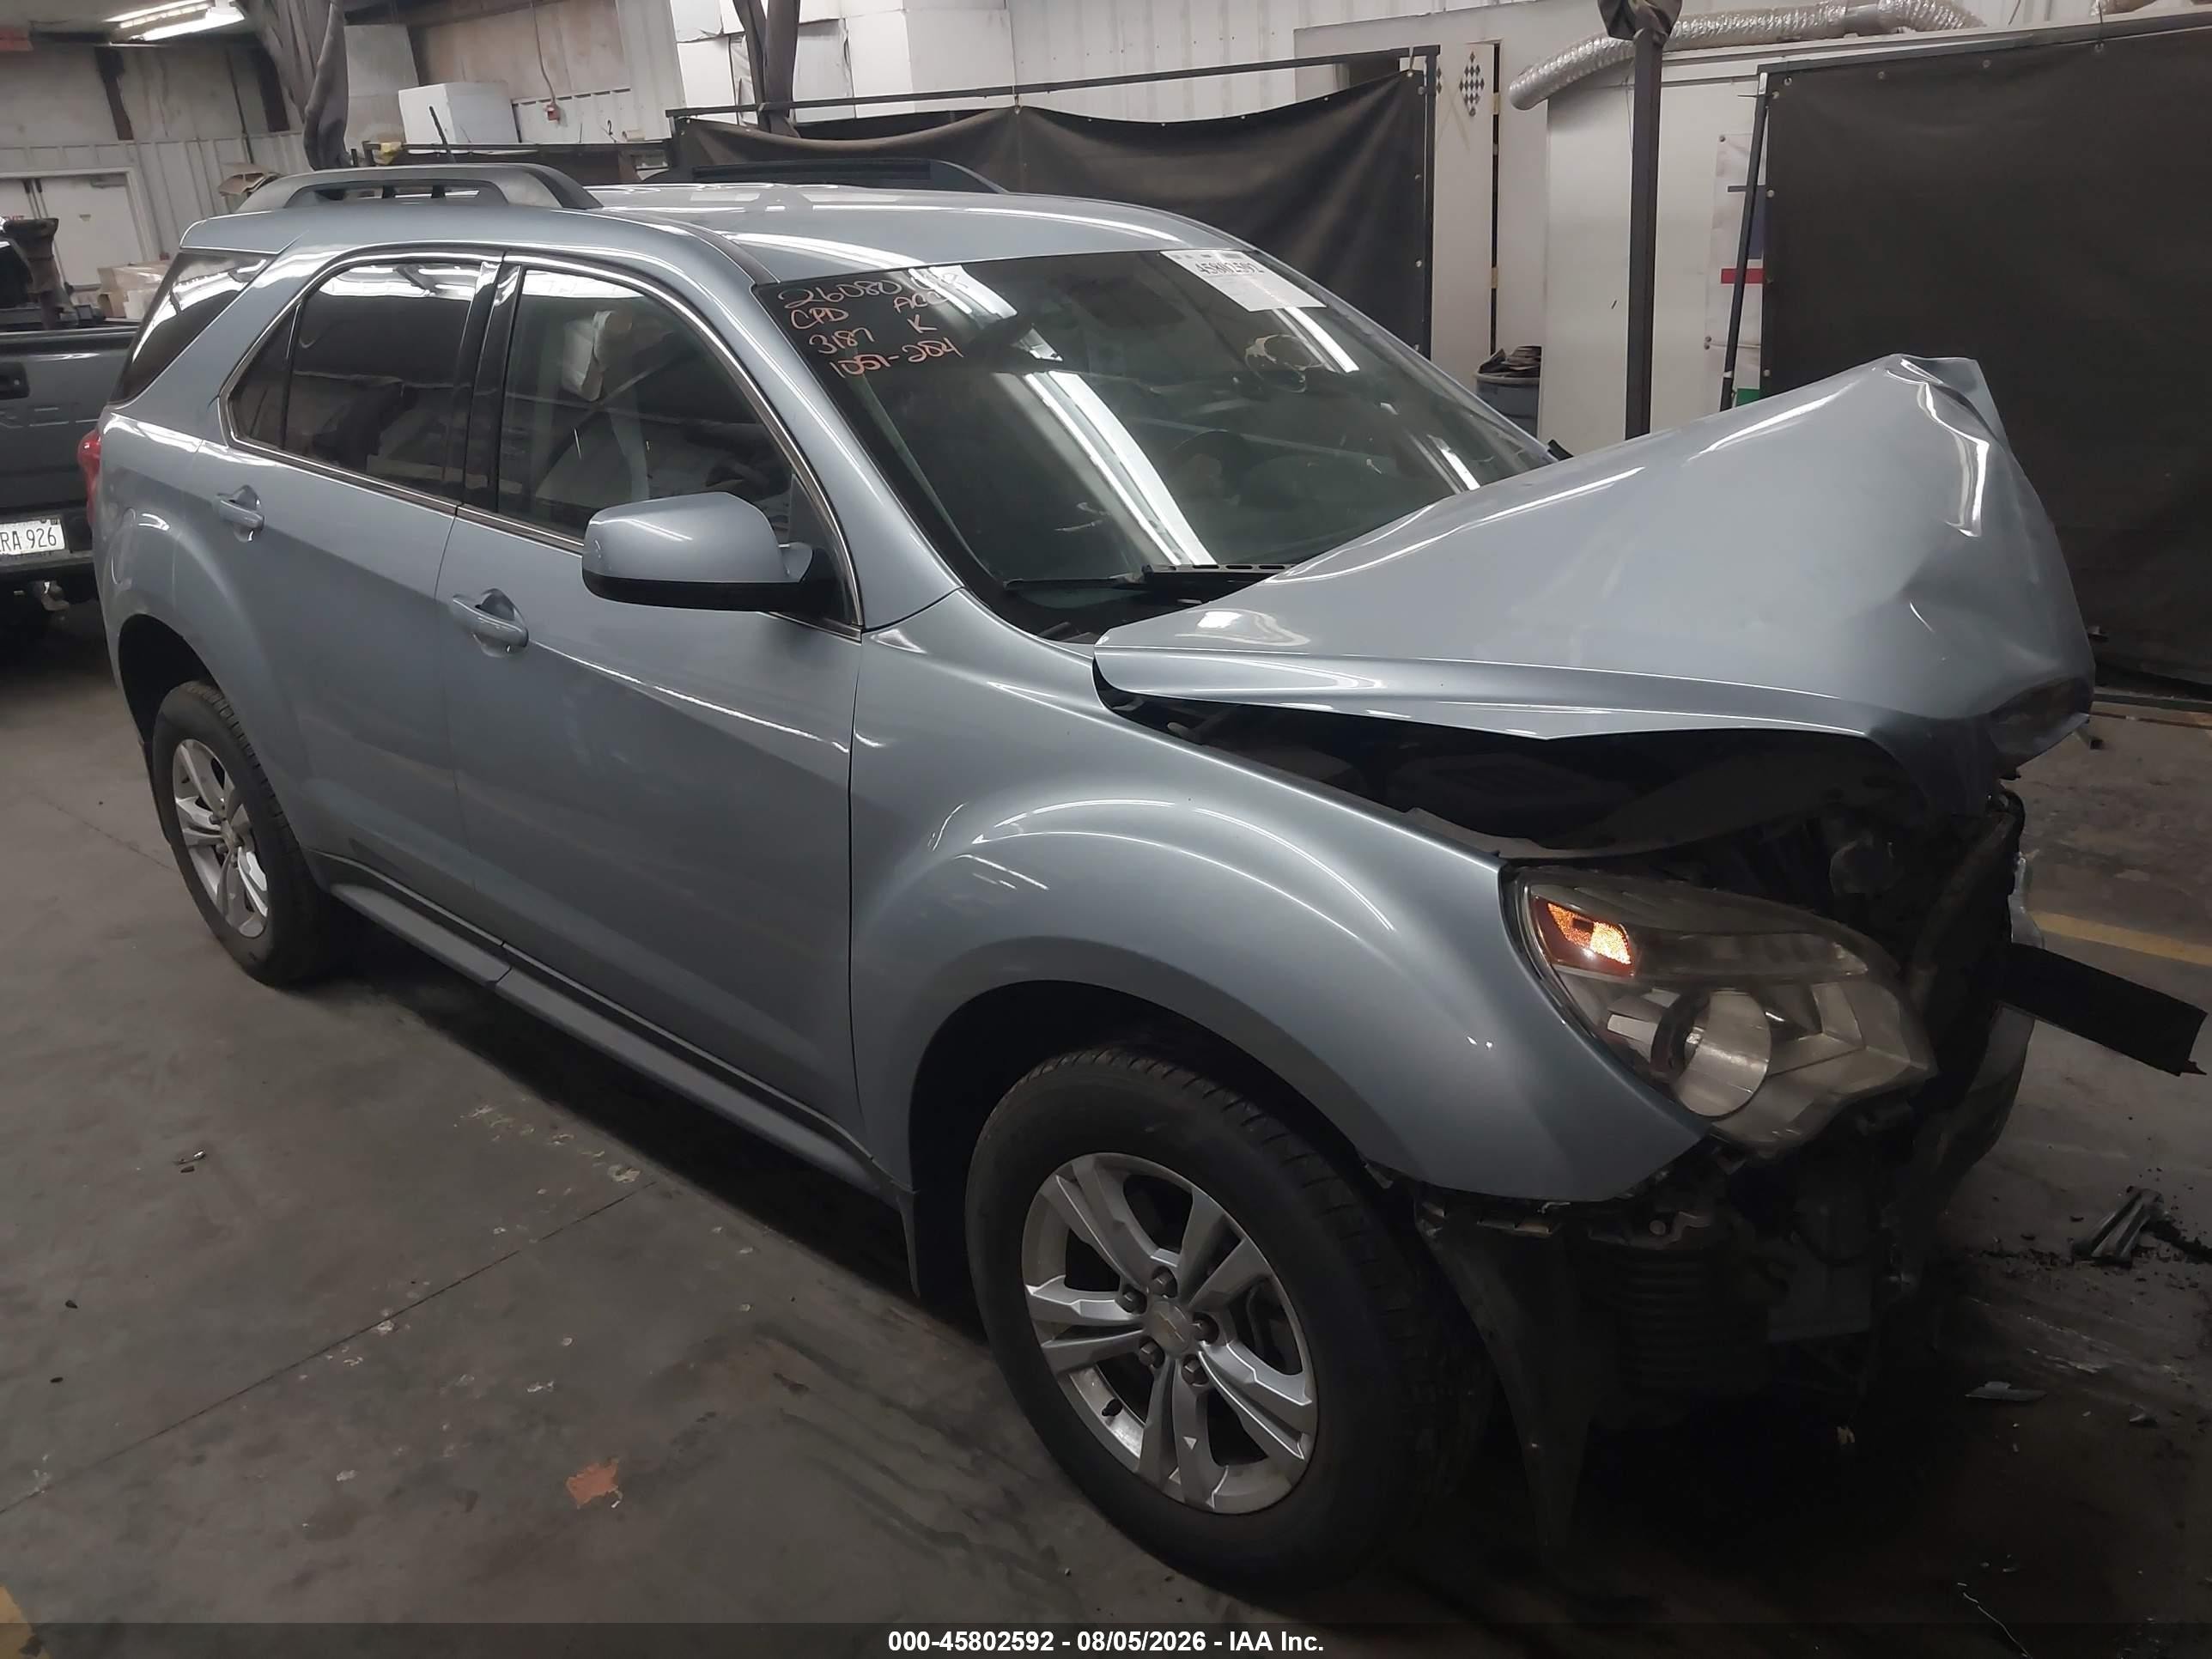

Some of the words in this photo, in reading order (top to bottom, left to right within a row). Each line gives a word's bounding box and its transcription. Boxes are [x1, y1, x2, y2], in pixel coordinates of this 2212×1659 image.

[791, 307, 849, 329] CPD
[907, 314, 938, 333] K
[26, 526, 57, 549] 926
